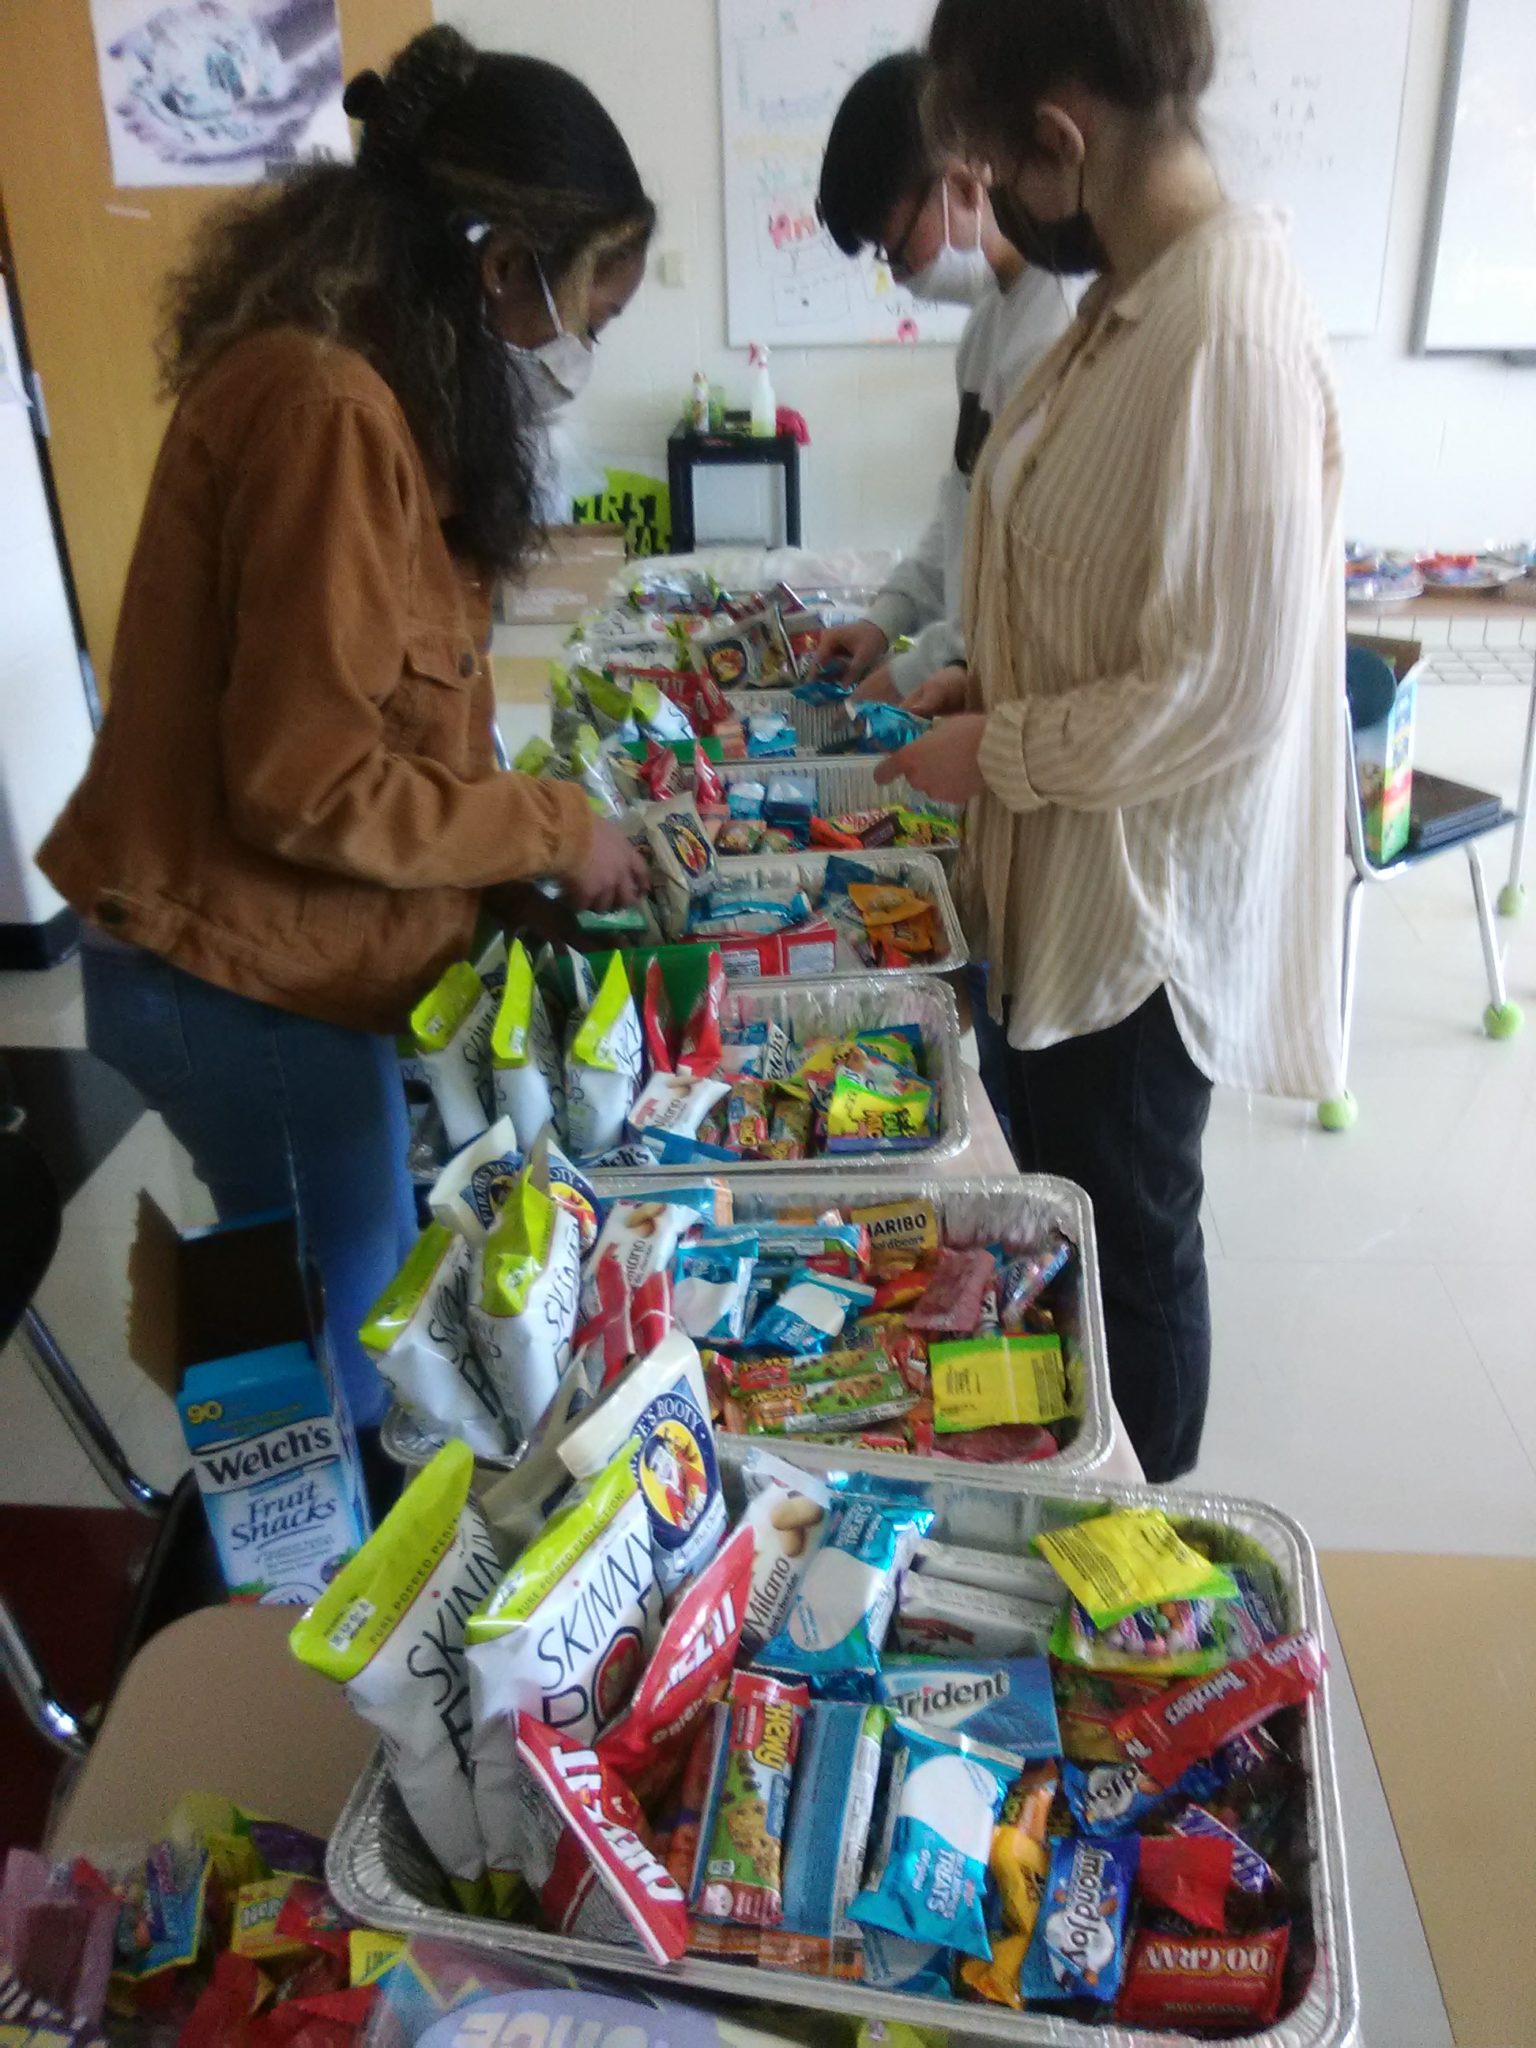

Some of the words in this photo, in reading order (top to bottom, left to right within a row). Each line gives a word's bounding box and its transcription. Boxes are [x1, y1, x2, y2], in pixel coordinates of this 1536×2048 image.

[657, 1398, 702, 1433] BOOTY
[202, 1426, 332, 1485] Welch's
[231, 1498, 336, 1550] Snacks
[248, 1480, 317, 1522] Fruit
[538, 1550, 574, 1591] POPPED
[743, 1556, 792, 1636] Milano
[368, 1612, 395, 1647] PURE
[391, 1558, 433, 1611] POPPED
[536, 1527, 654, 1690] SKINNY
[895, 1671, 1009, 1714] Trident
[1163, 1669, 1248, 1726] Twizzlers
[926, 1849, 956, 1914] TREATS
